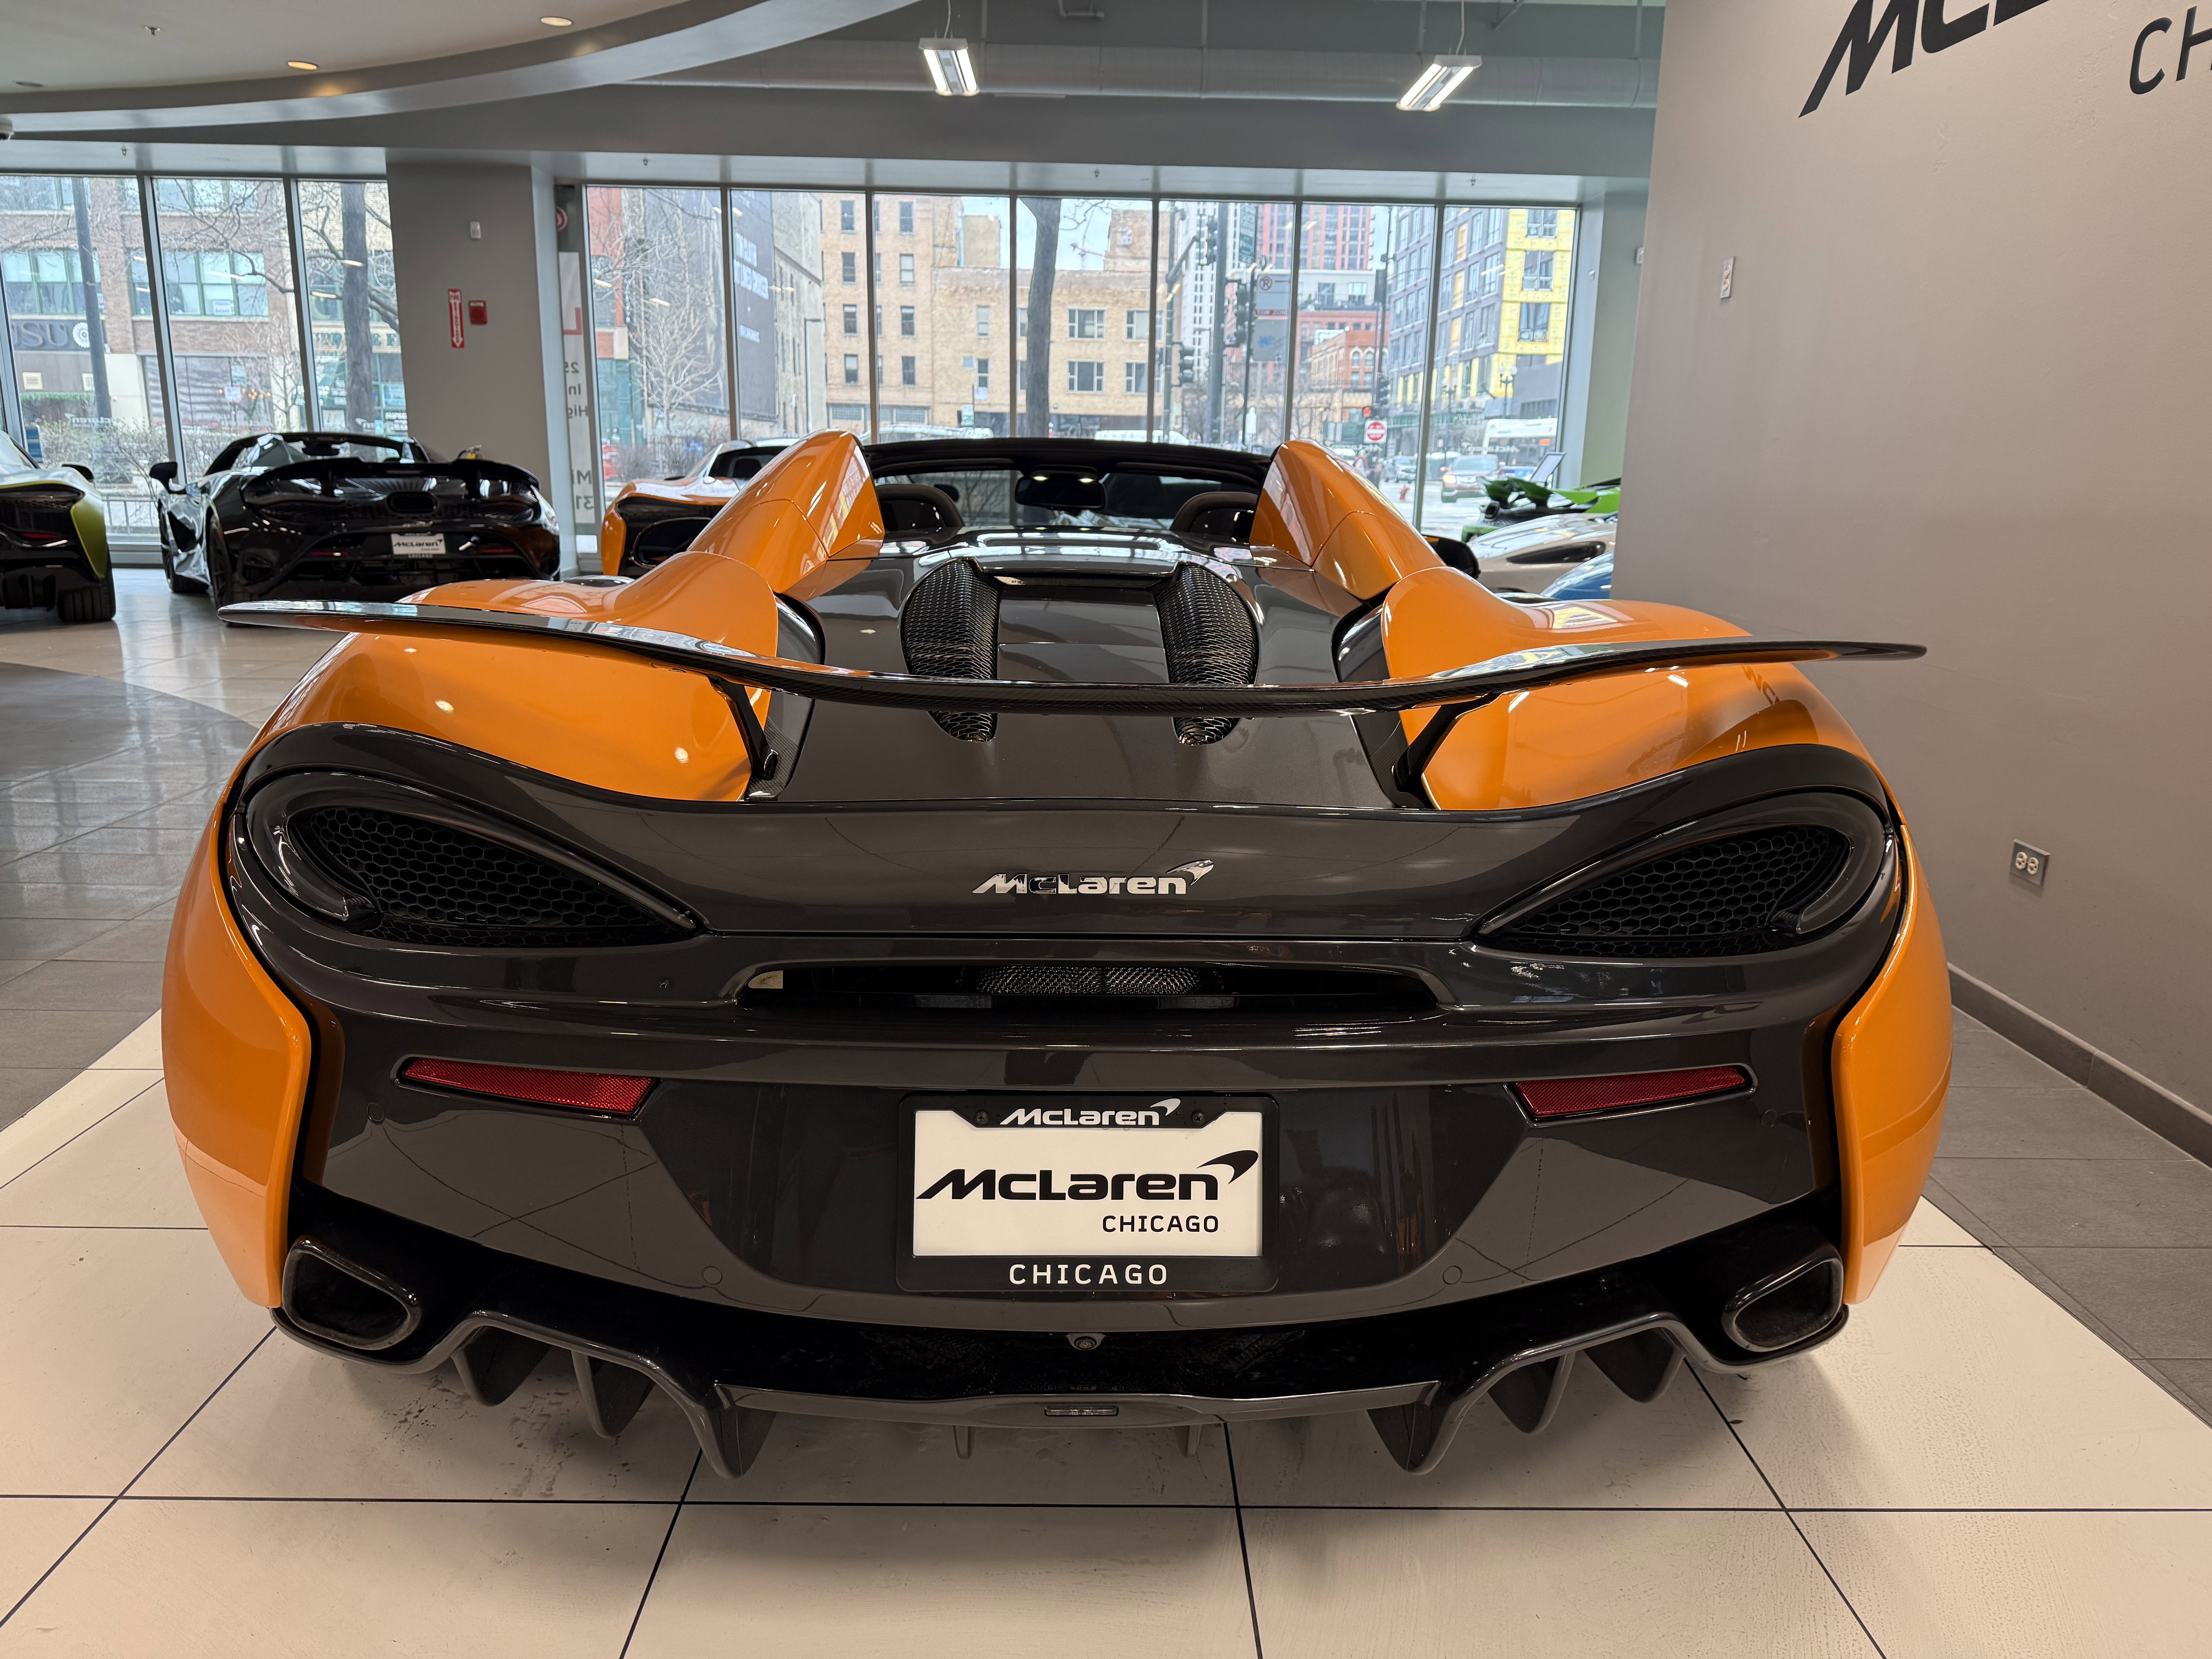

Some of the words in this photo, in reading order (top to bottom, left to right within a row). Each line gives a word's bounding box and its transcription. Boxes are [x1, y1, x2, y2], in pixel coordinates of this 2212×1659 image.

[972, 874, 1187, 895] McLaren
[1000, 1108, 1161, 1125] McLaren
[916, 1169, 1219, 1200] McLaren
[1102, 1215, 1219, 1233] CHICAGO
[1009, 1264, 1167, 1285] CHICAGO
